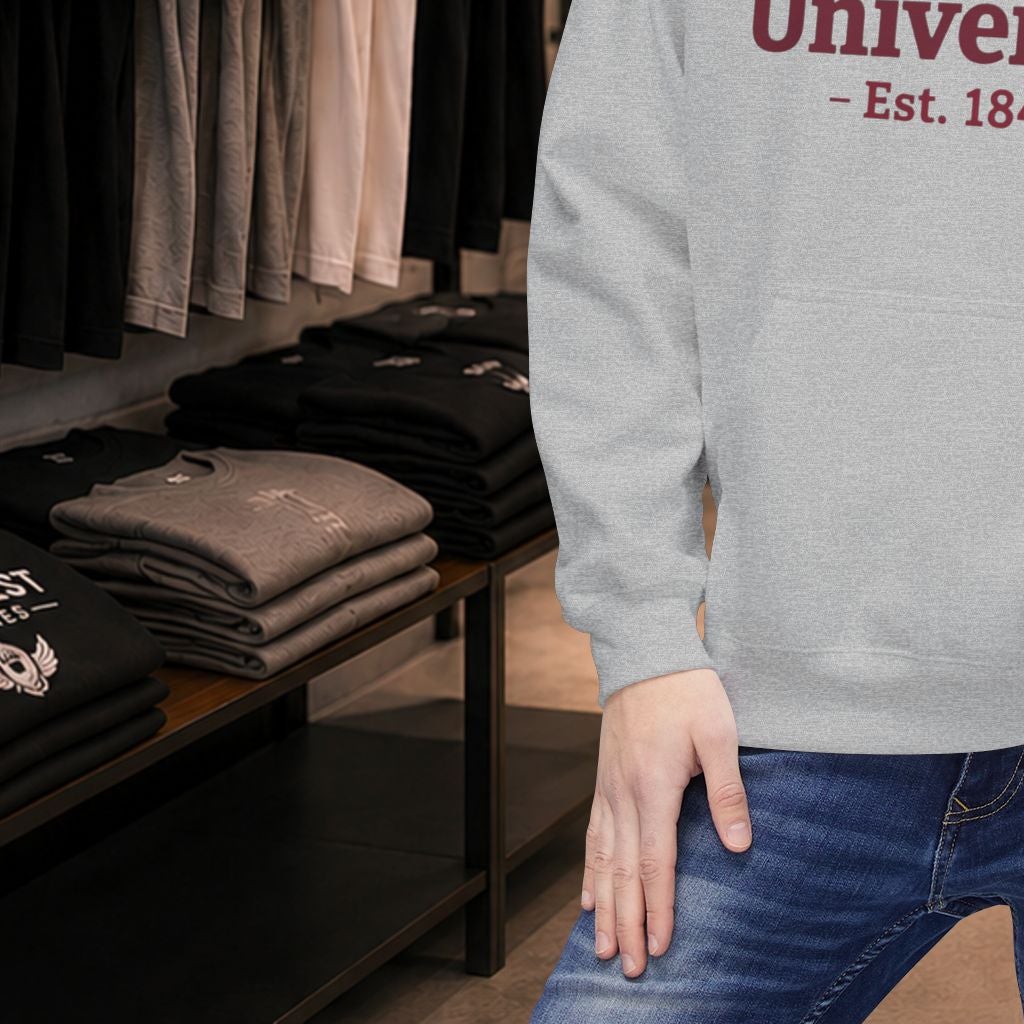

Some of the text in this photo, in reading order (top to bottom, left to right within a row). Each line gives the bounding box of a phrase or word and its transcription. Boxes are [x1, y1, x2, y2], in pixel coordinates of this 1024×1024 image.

[863, 80, 948, 125] Est.
[0, 569, 45, 601] ST
[0, 604, 30, 627] ES
